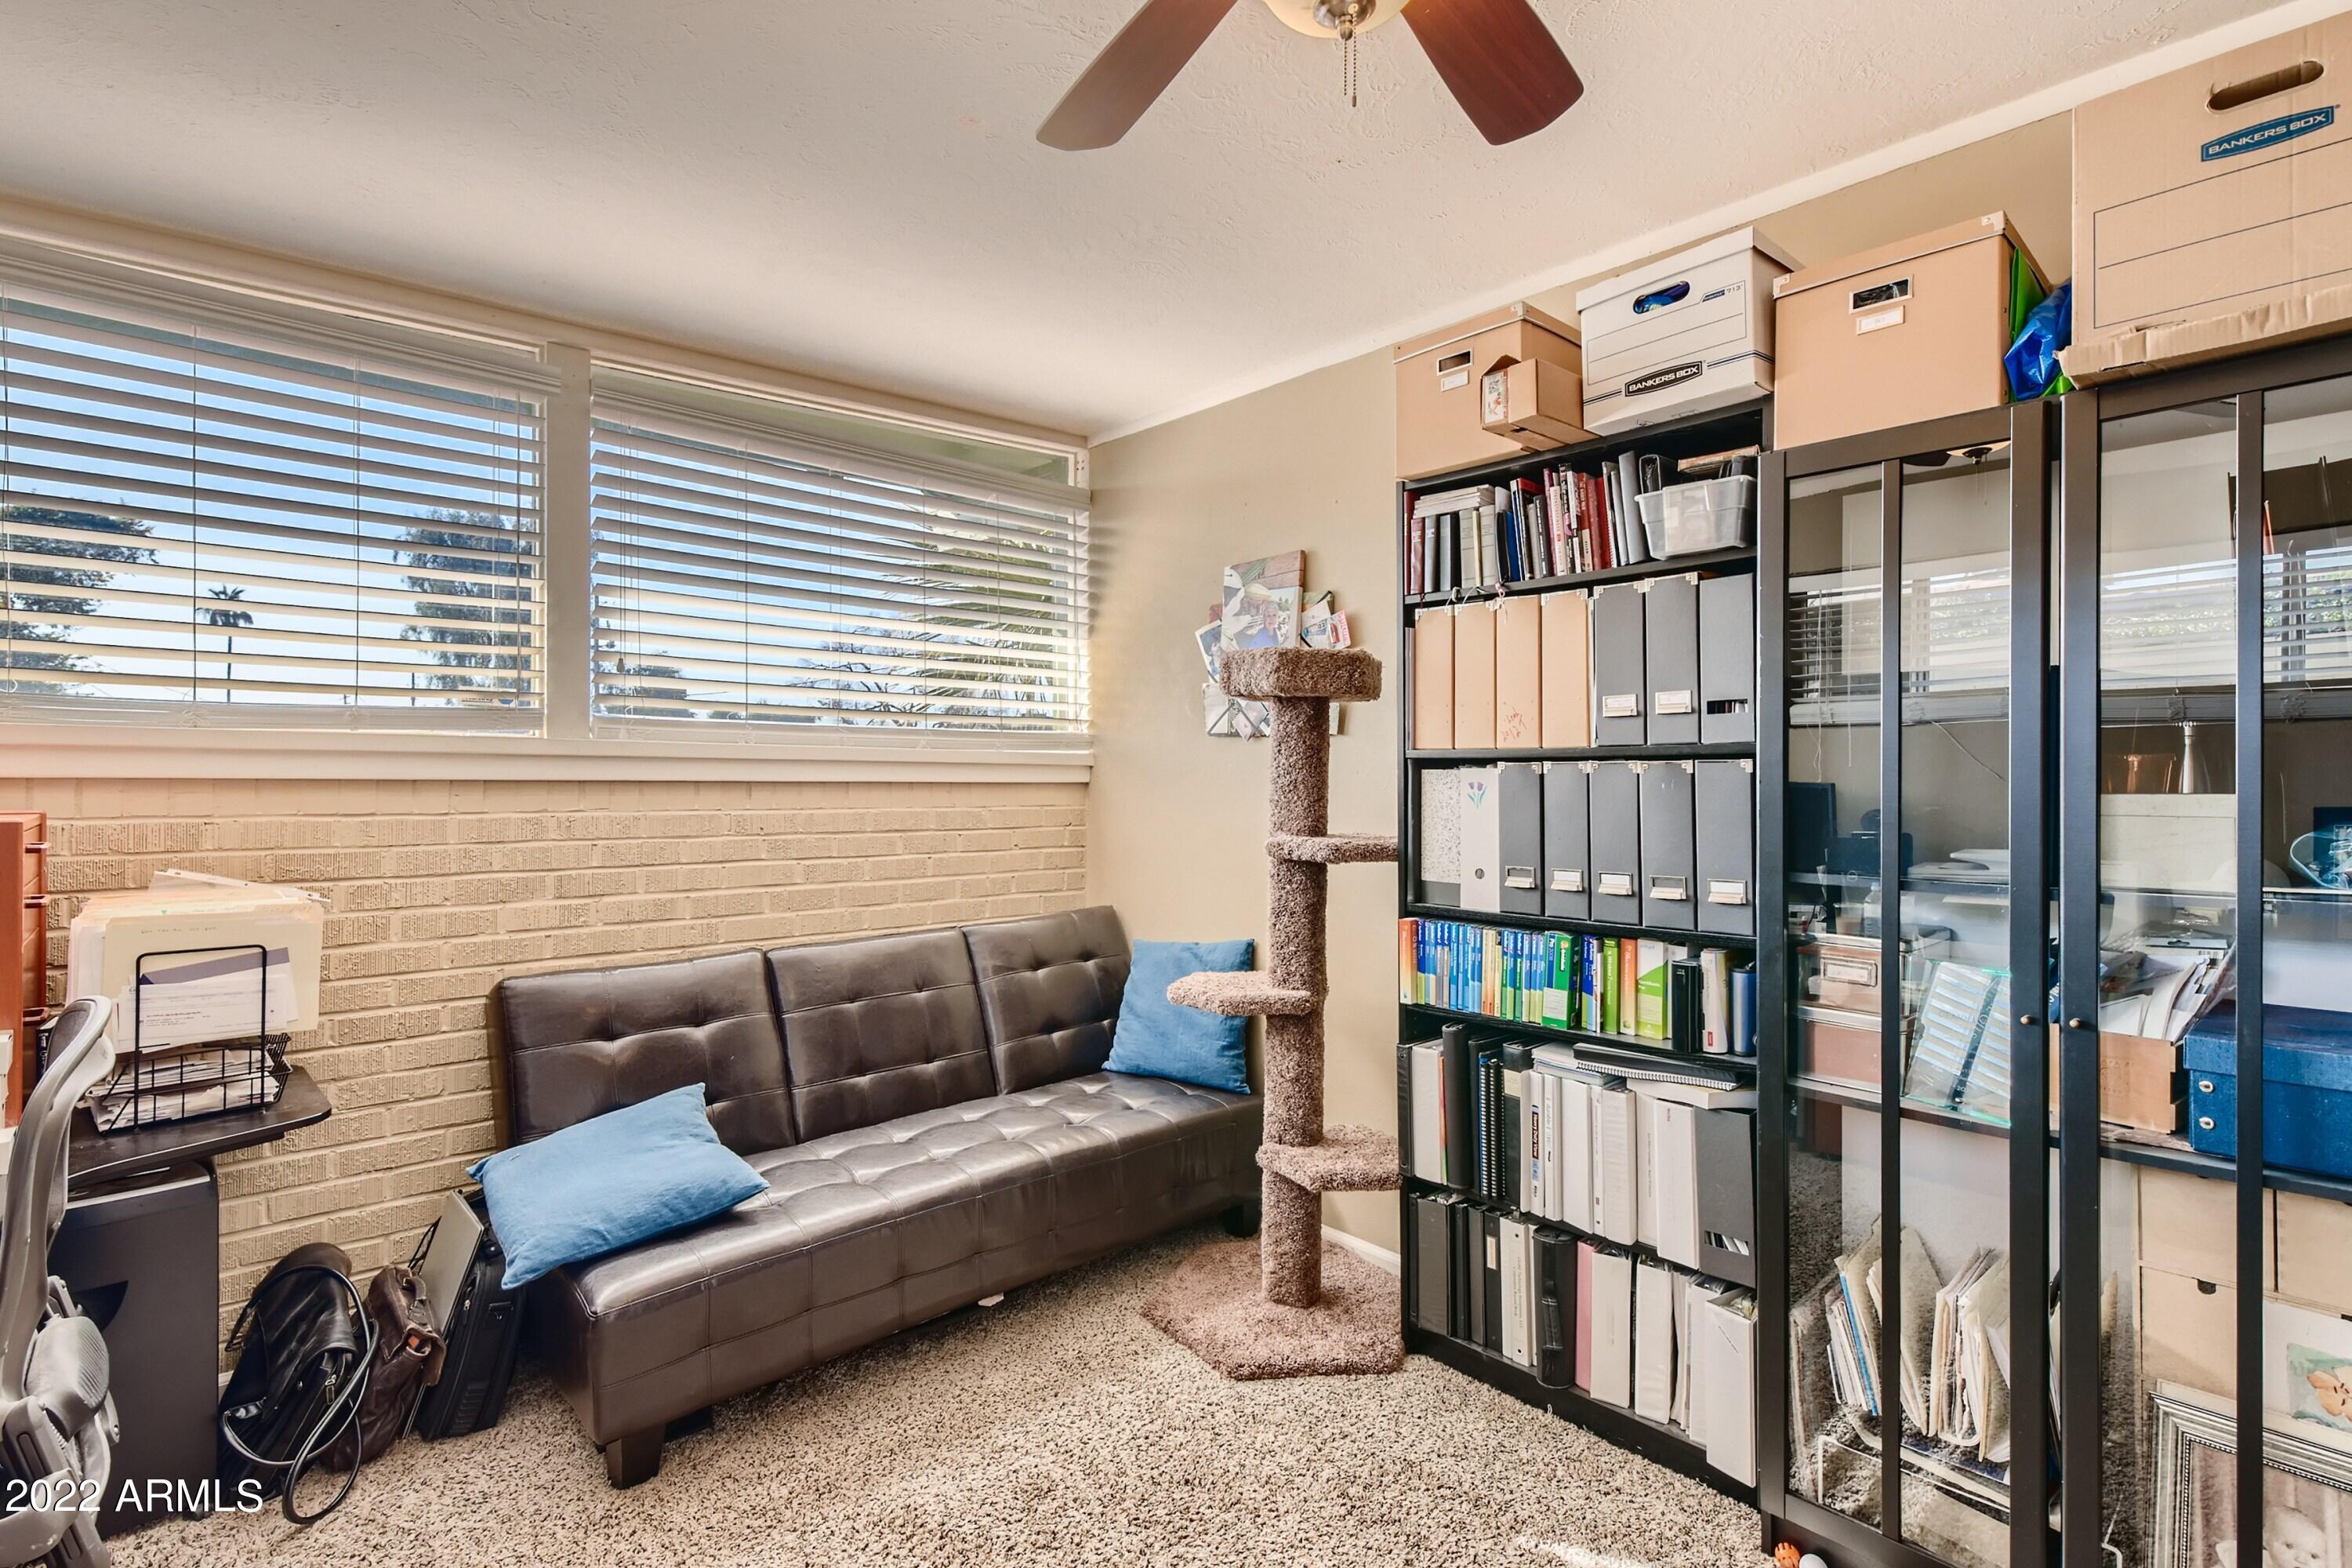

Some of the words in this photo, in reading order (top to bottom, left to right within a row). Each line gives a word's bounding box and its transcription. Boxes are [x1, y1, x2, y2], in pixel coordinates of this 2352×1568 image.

[2208, 125, 2287, 155] BANKERS
[2289, 113, 2327, 132] BOX
[1628, 370, 1676, 392] BANKERS
[1675, 365, 1699, 379] BOX
